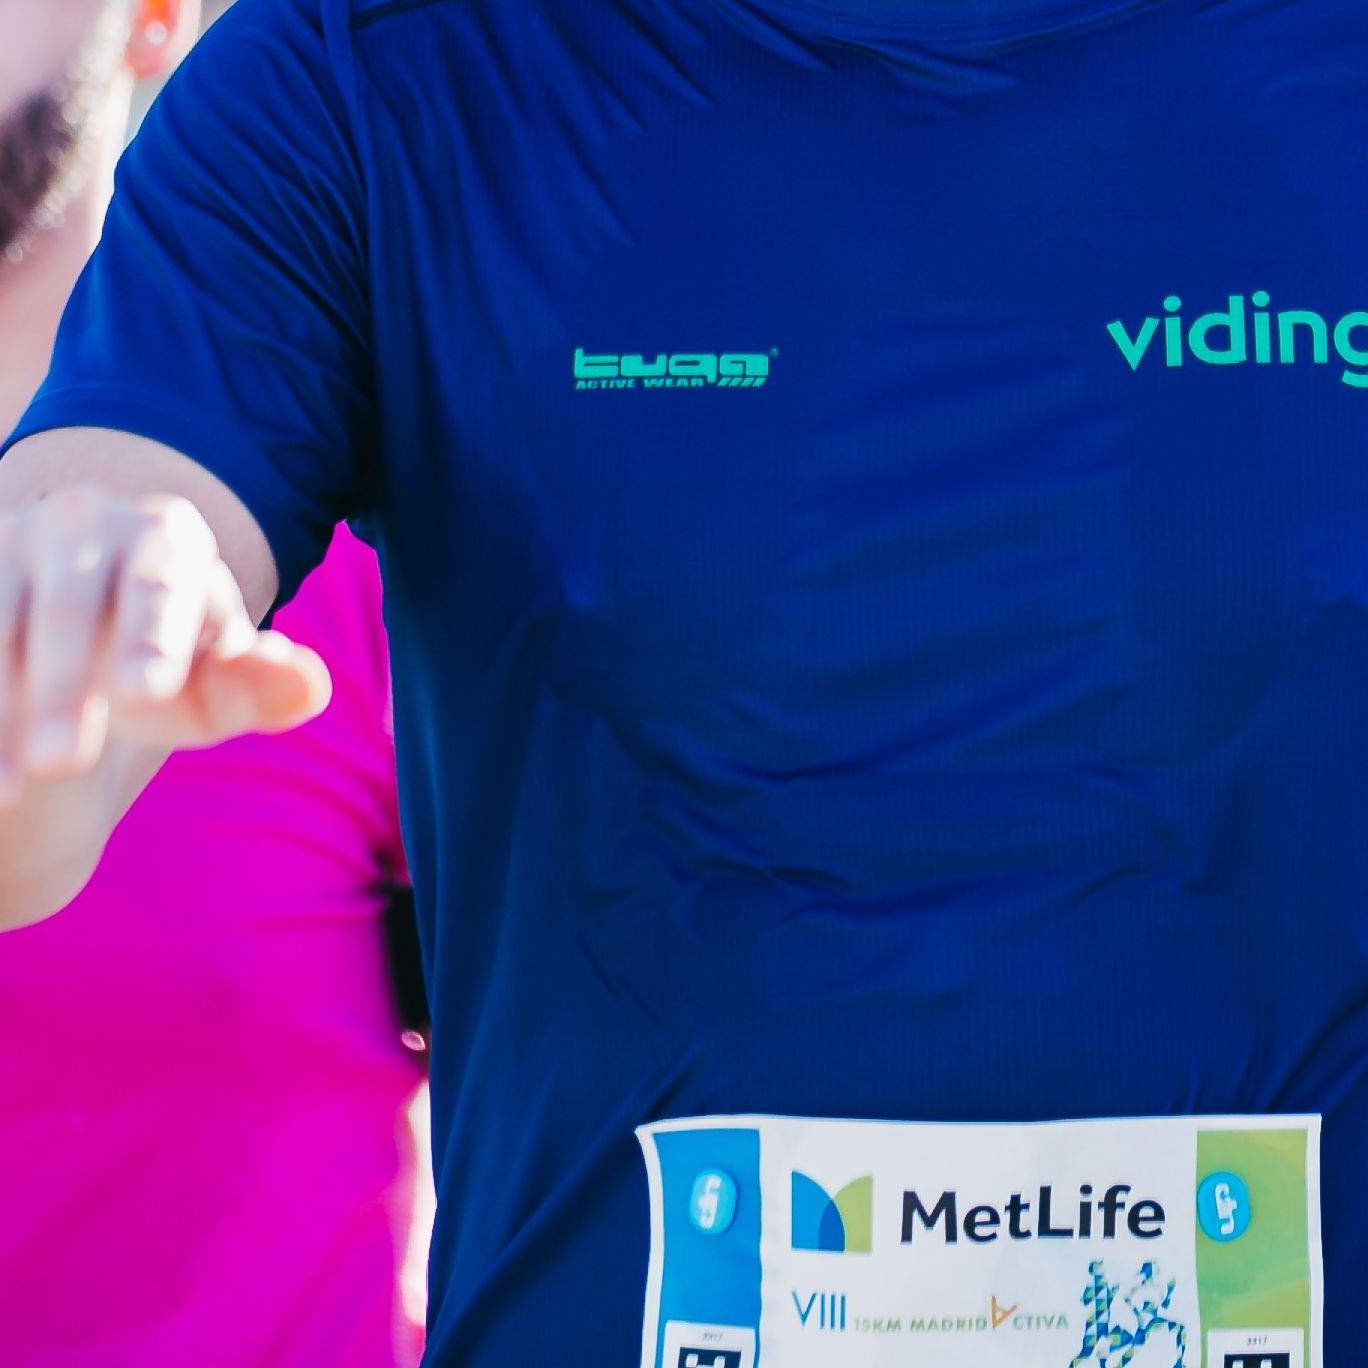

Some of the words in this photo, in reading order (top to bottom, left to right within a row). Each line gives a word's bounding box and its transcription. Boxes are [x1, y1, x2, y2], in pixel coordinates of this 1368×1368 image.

[900, 1184, 1167, 1244] MetLife
[791, 1290, 847, 1331] VIII
[909, 1314, 988, 1332] MADRID
